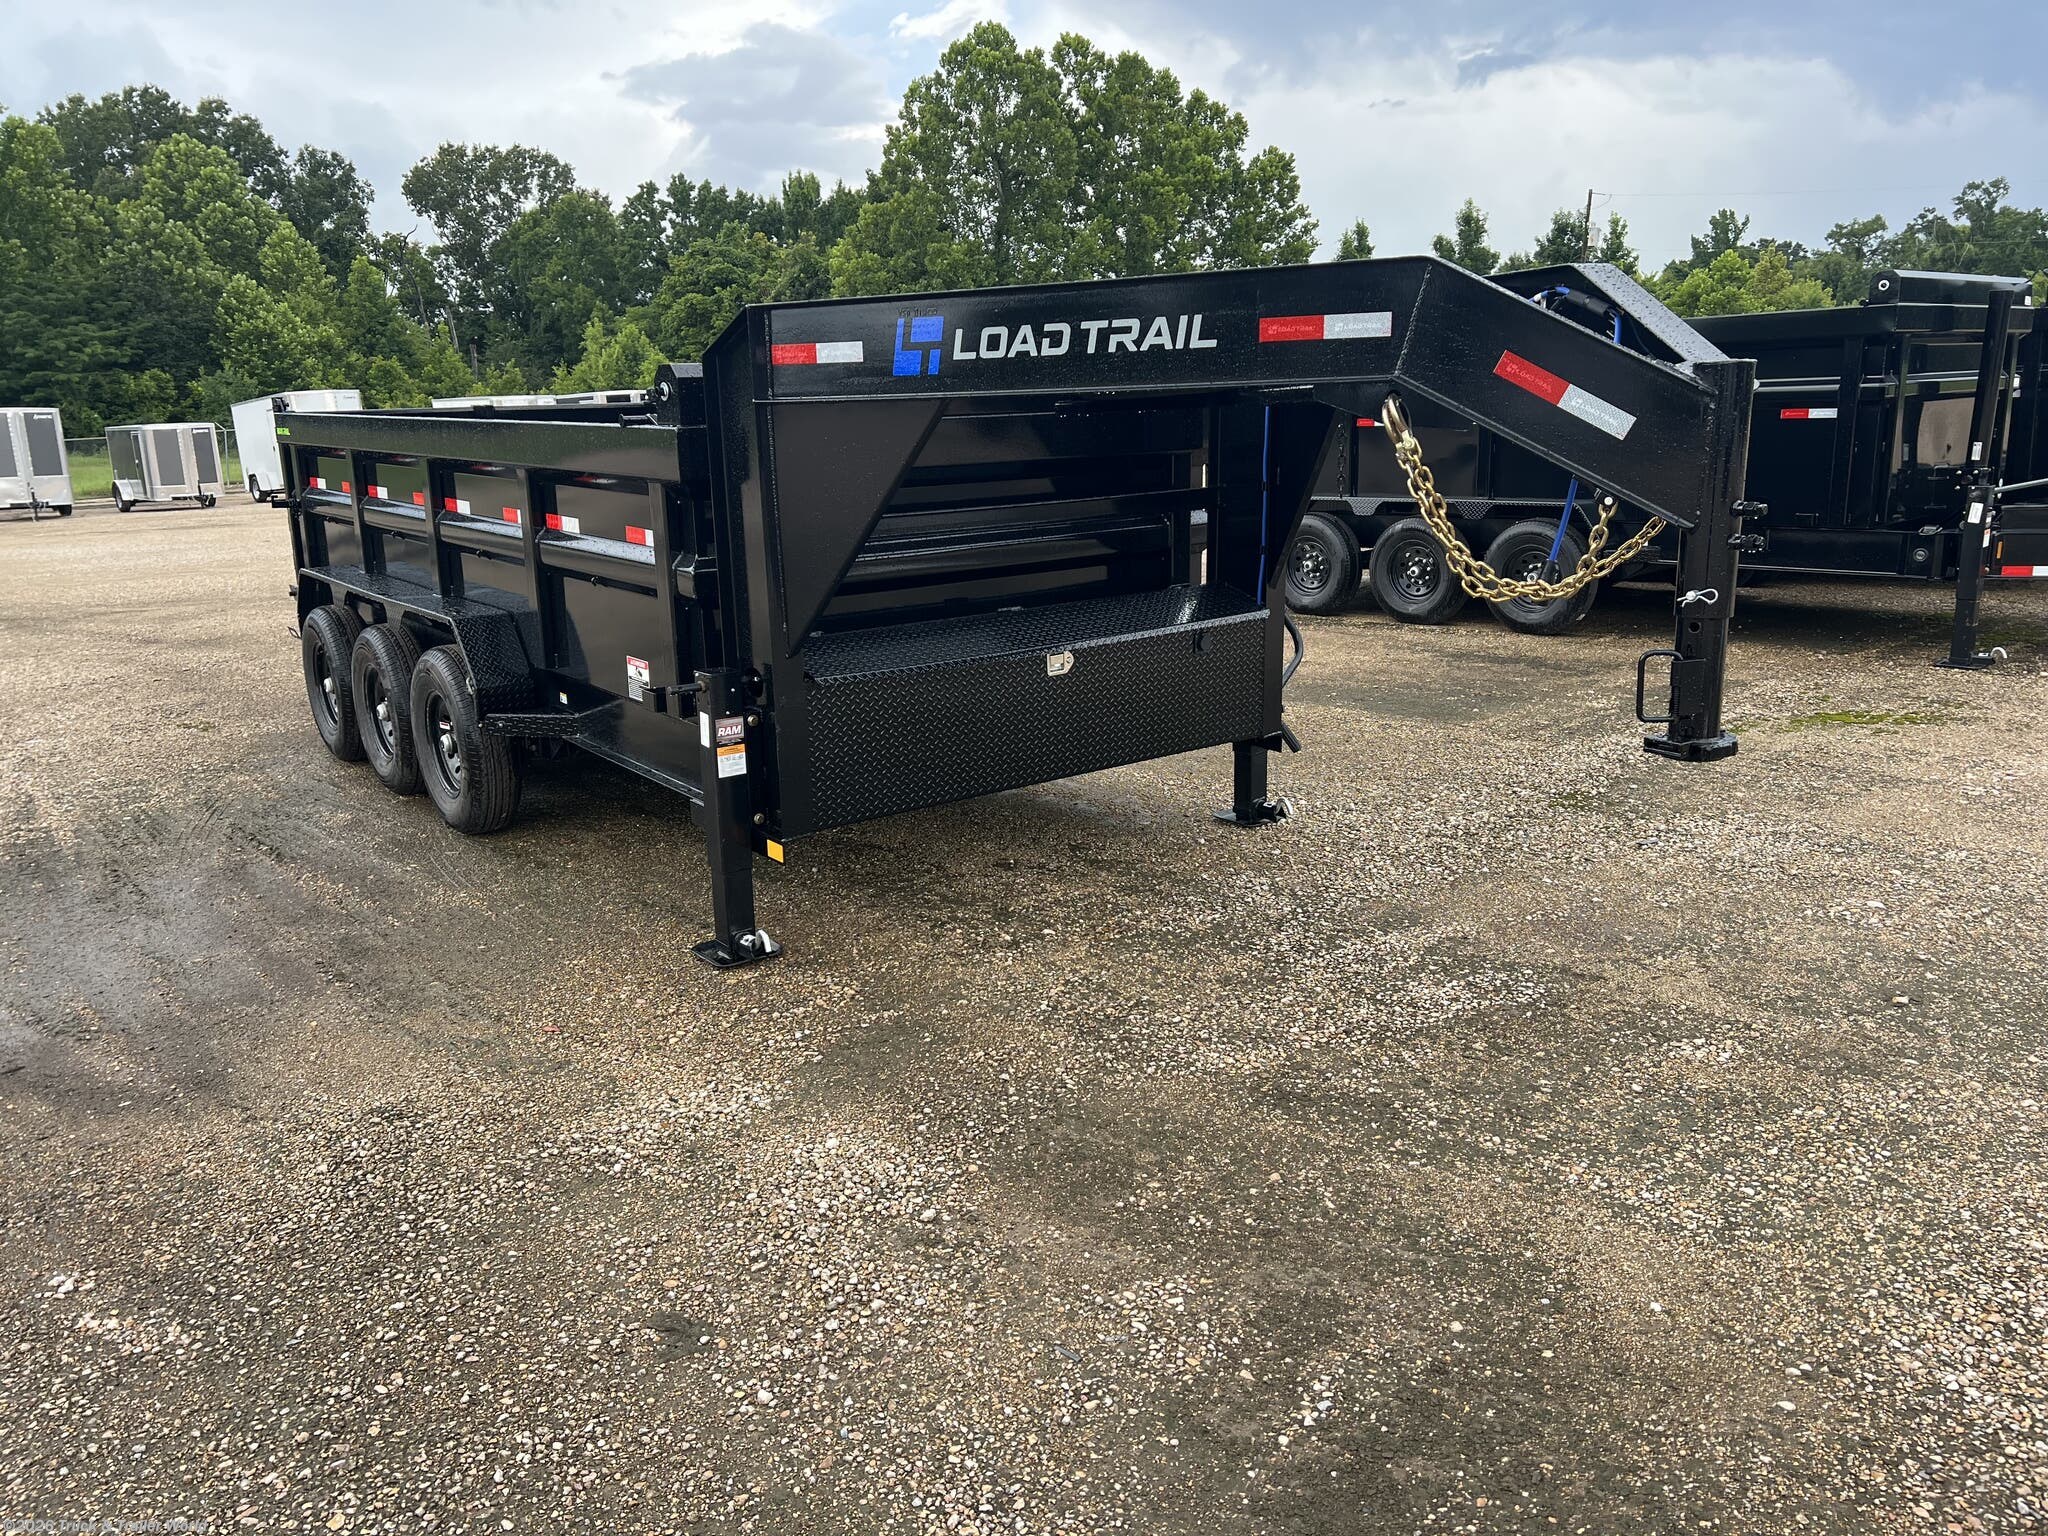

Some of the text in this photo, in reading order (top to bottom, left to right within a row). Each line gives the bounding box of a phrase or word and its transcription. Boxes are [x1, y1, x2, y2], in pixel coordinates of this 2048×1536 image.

[953, 322, 1072, 360] LOAD
[1080, 314, 1218, 353] TRAIL
[717, 724, 742, 737] RAM
